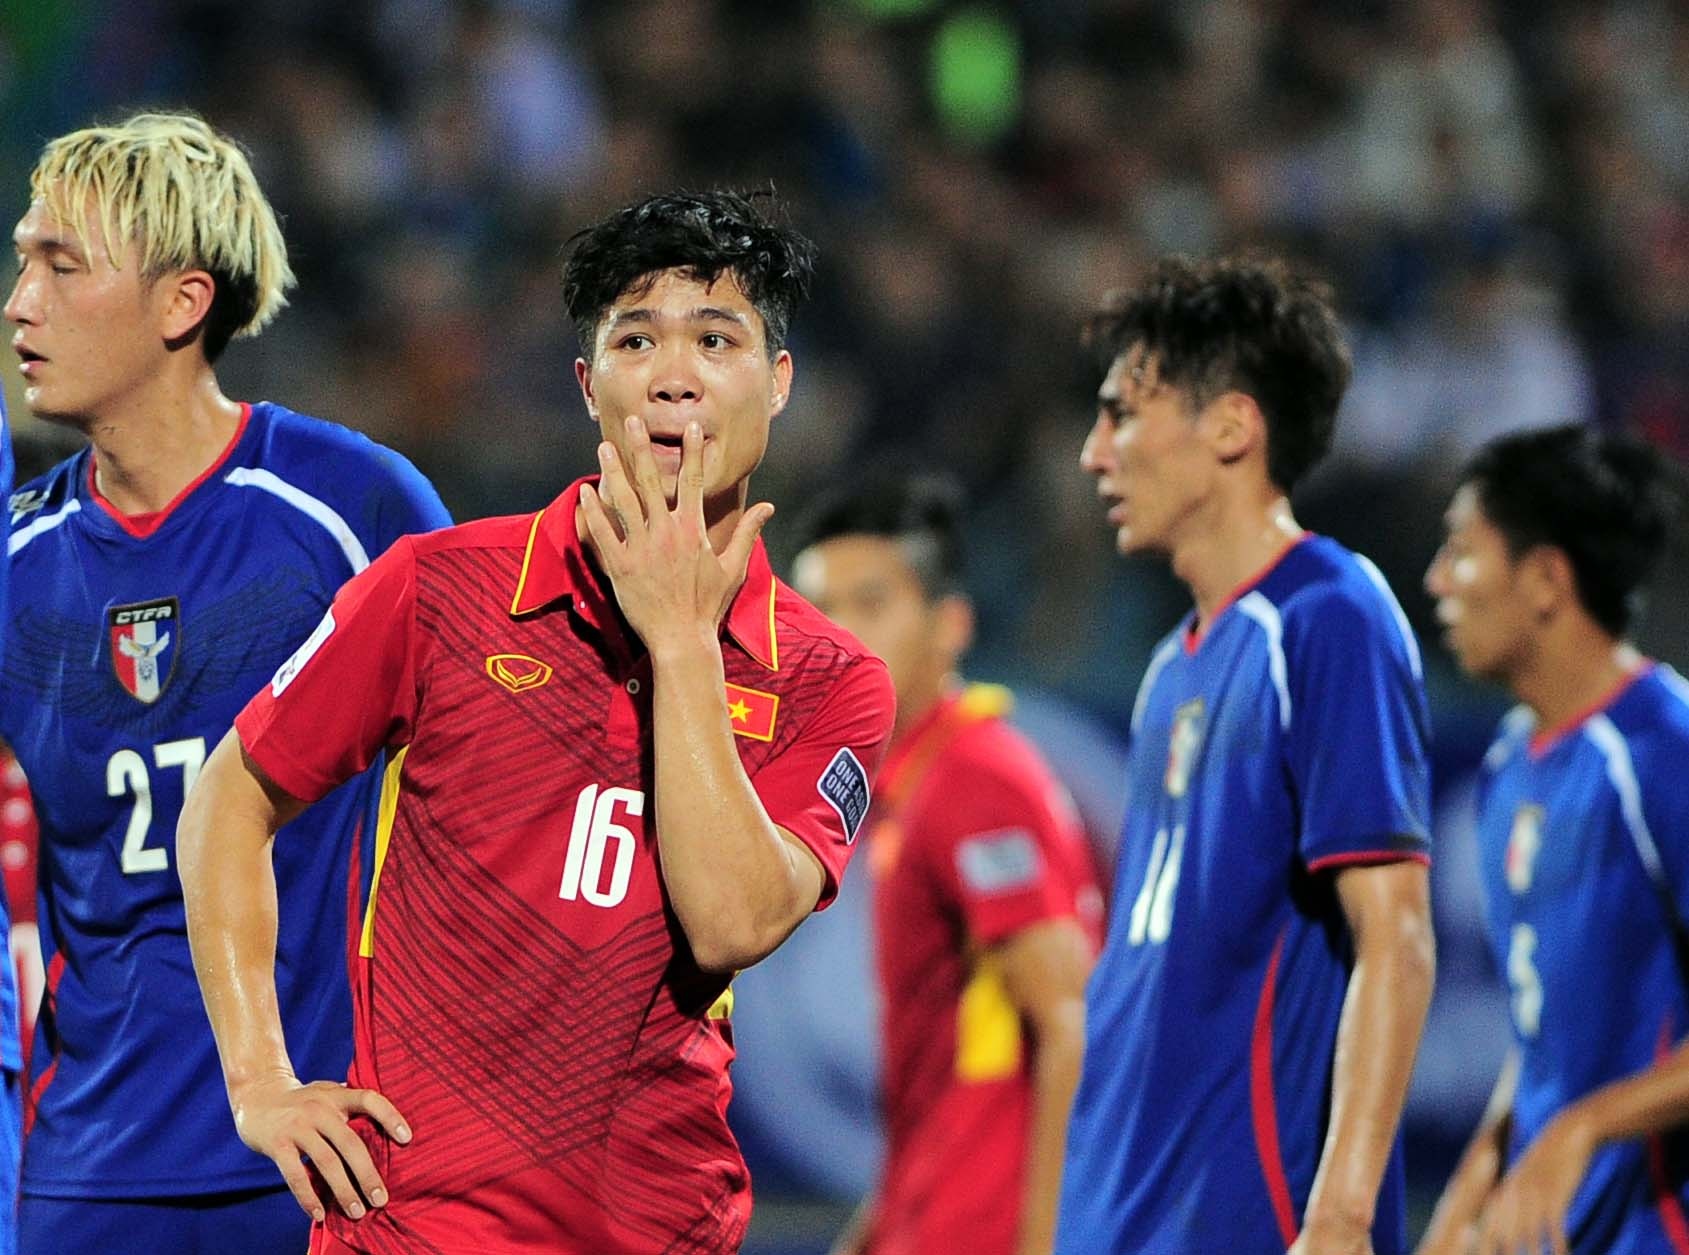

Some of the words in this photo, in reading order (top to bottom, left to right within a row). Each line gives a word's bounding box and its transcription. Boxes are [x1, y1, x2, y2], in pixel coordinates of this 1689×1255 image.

[116, 606, 172, 624] CTFA
[106, 736, 206, 874] 27
[826, 774, 850, 804] ONE
[835, 760, 858, 791] ONE
[558, 783, 645, 908] 16
[1127, 823, 1187, 946] 11
